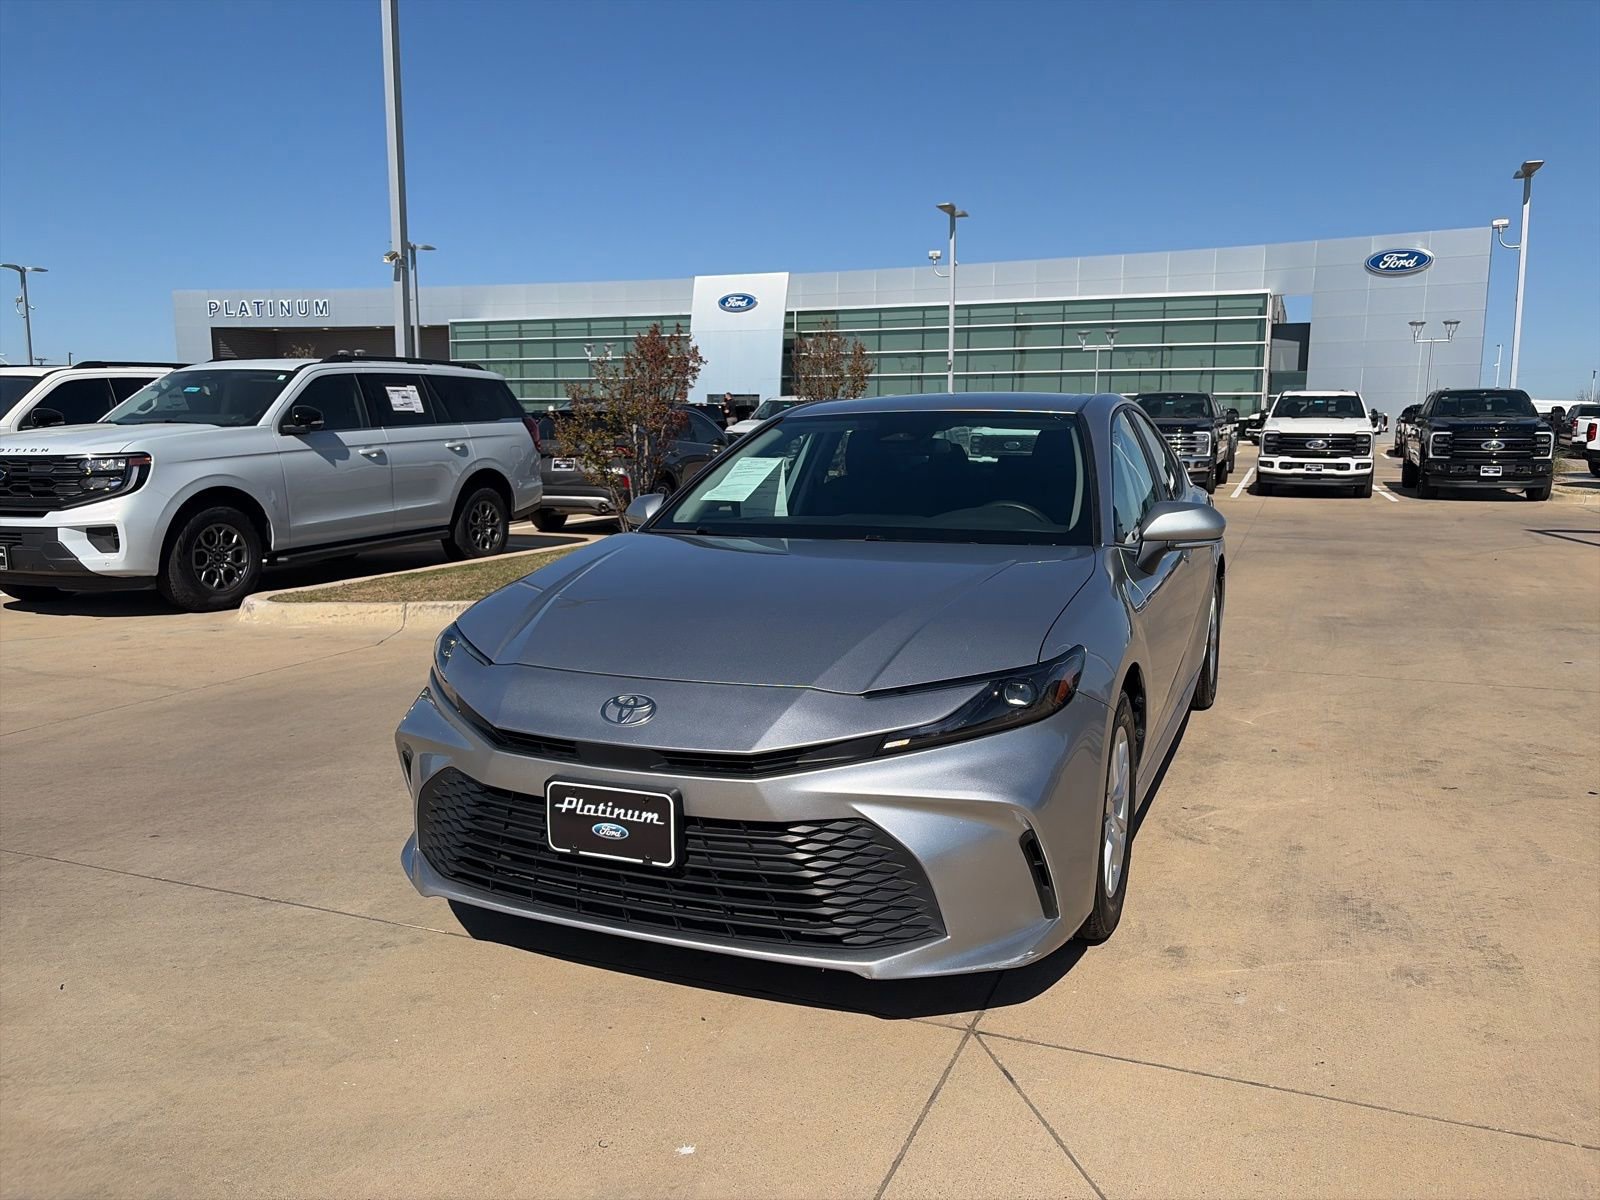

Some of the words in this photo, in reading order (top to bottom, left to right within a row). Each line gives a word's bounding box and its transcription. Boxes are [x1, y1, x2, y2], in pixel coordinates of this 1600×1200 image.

[1379, 253, 1419, 269] Ford
[207, 299, 330, 317] PLATINUM
[725, 296, 749, 307] Ford
[554, 797, 665, 825] Platinum
[599, 825, 621, 838] Ford
